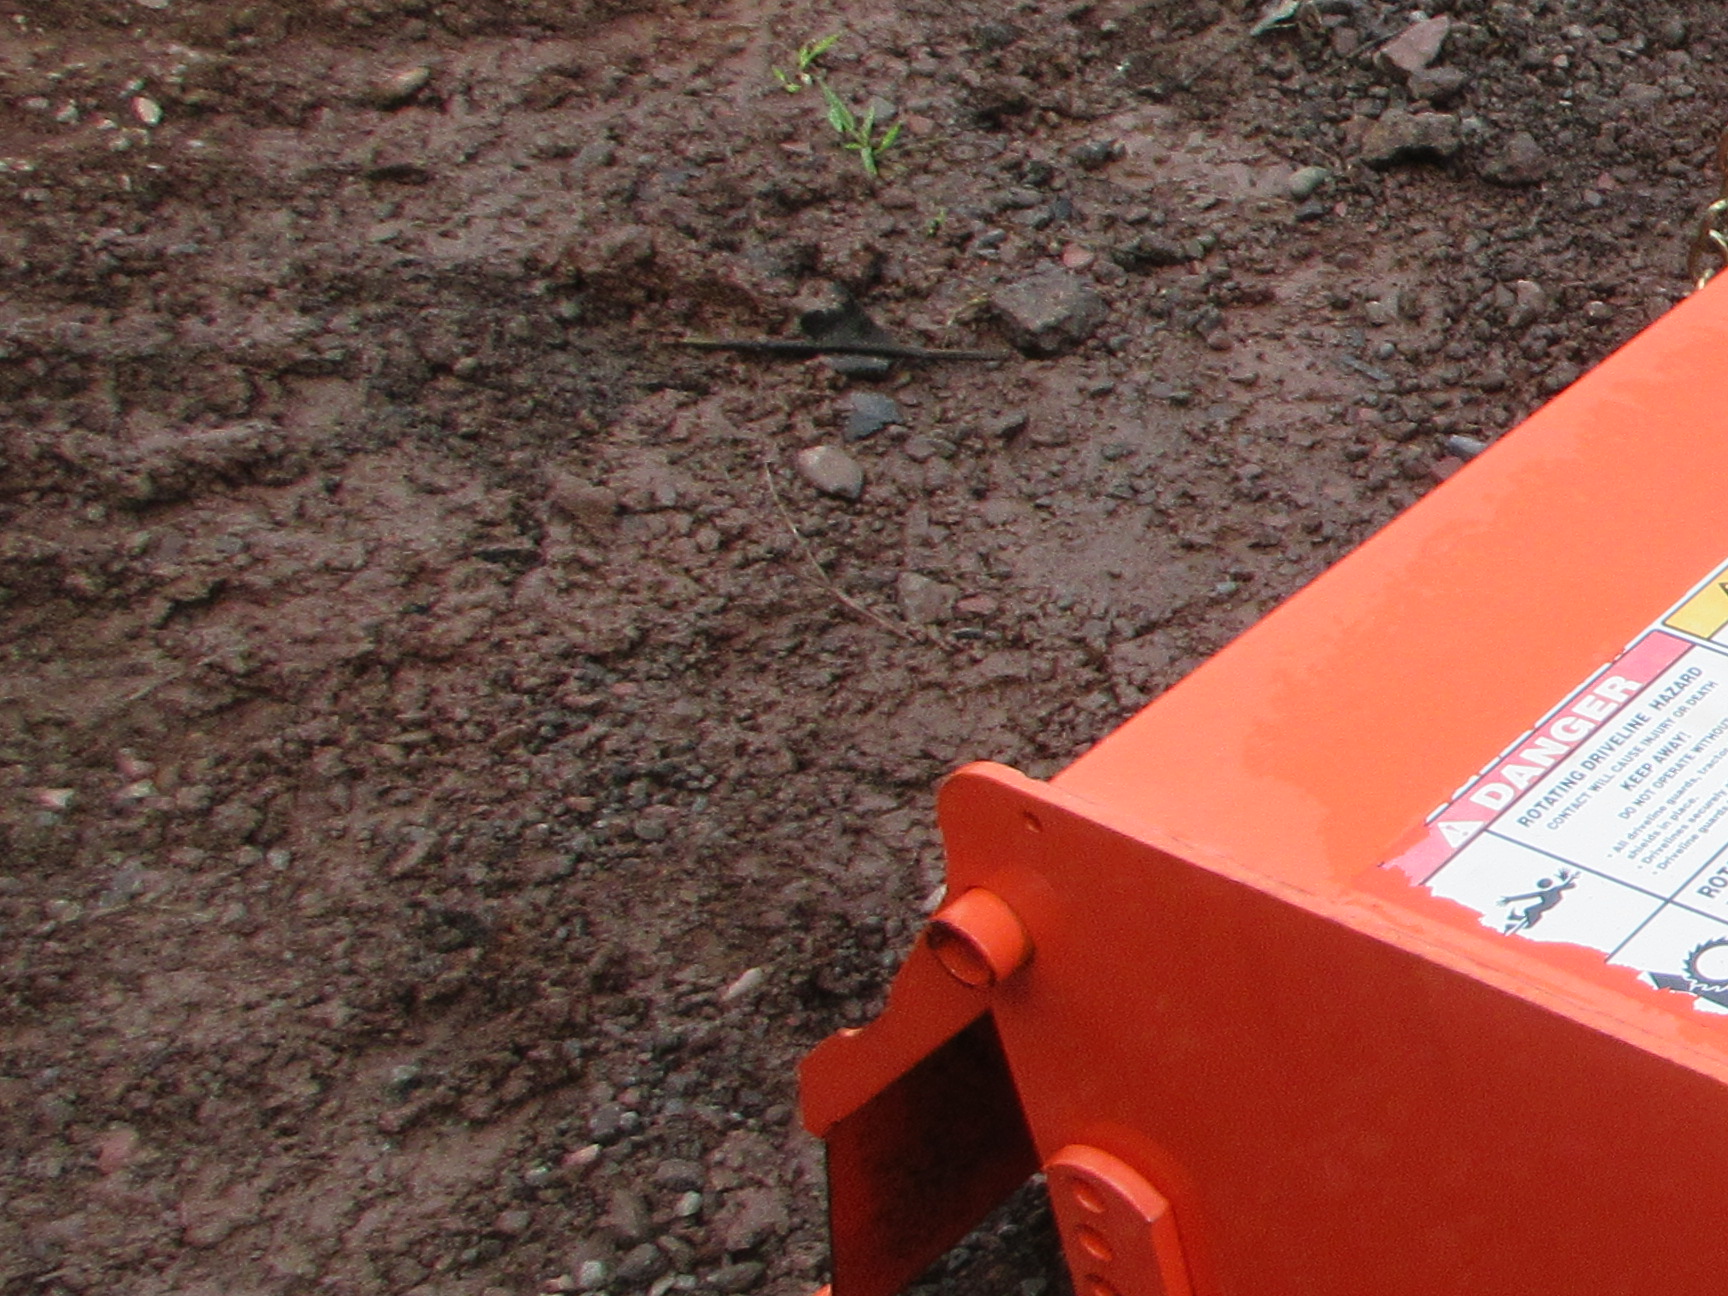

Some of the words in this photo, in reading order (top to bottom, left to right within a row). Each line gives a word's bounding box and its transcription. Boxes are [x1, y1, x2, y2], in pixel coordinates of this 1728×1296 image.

[1469, 674, 1643, 812] DANGER
[1515, 769, 1587, 827] ROTATING
[1579, 712, 1652, 771] DRIVELINE
[1647, 665, 1705, 711] HAZARD
[1545, 791, 1592, 830] CONTACT
[1587, 772, 1616, 792] WILL
[1609, 745, 1645, 773] CAUSE
[1639, 717, 1676, 747] INJURY
[1671, 704, 1691, 718] OR
[1684, 680, 1719, 706] DEATH
[1619, 762, 1655, 791] KEEP
[1650, 730, 1689, 764] AWAY!
[1611, 839, 1630, 853] All
[1625, 804, 1669, 841] driveline
[1663, 775, 1702, 806] guards,
[1616, 805, 1638, 820] DO
[1631, 788, 1656, 807] NOT
[1651, 753, 1696, 789] OPERATE
[1625, 829, 1663, 860] shields
[1656, 819, 1674, 831] in
[1667, 795, 1700, 822] place.
[1640, 823, 1691, 865] Drivelines
[1685, 788, 1728, 824] securely
[1655, 832, 1701, 871] Driveline
